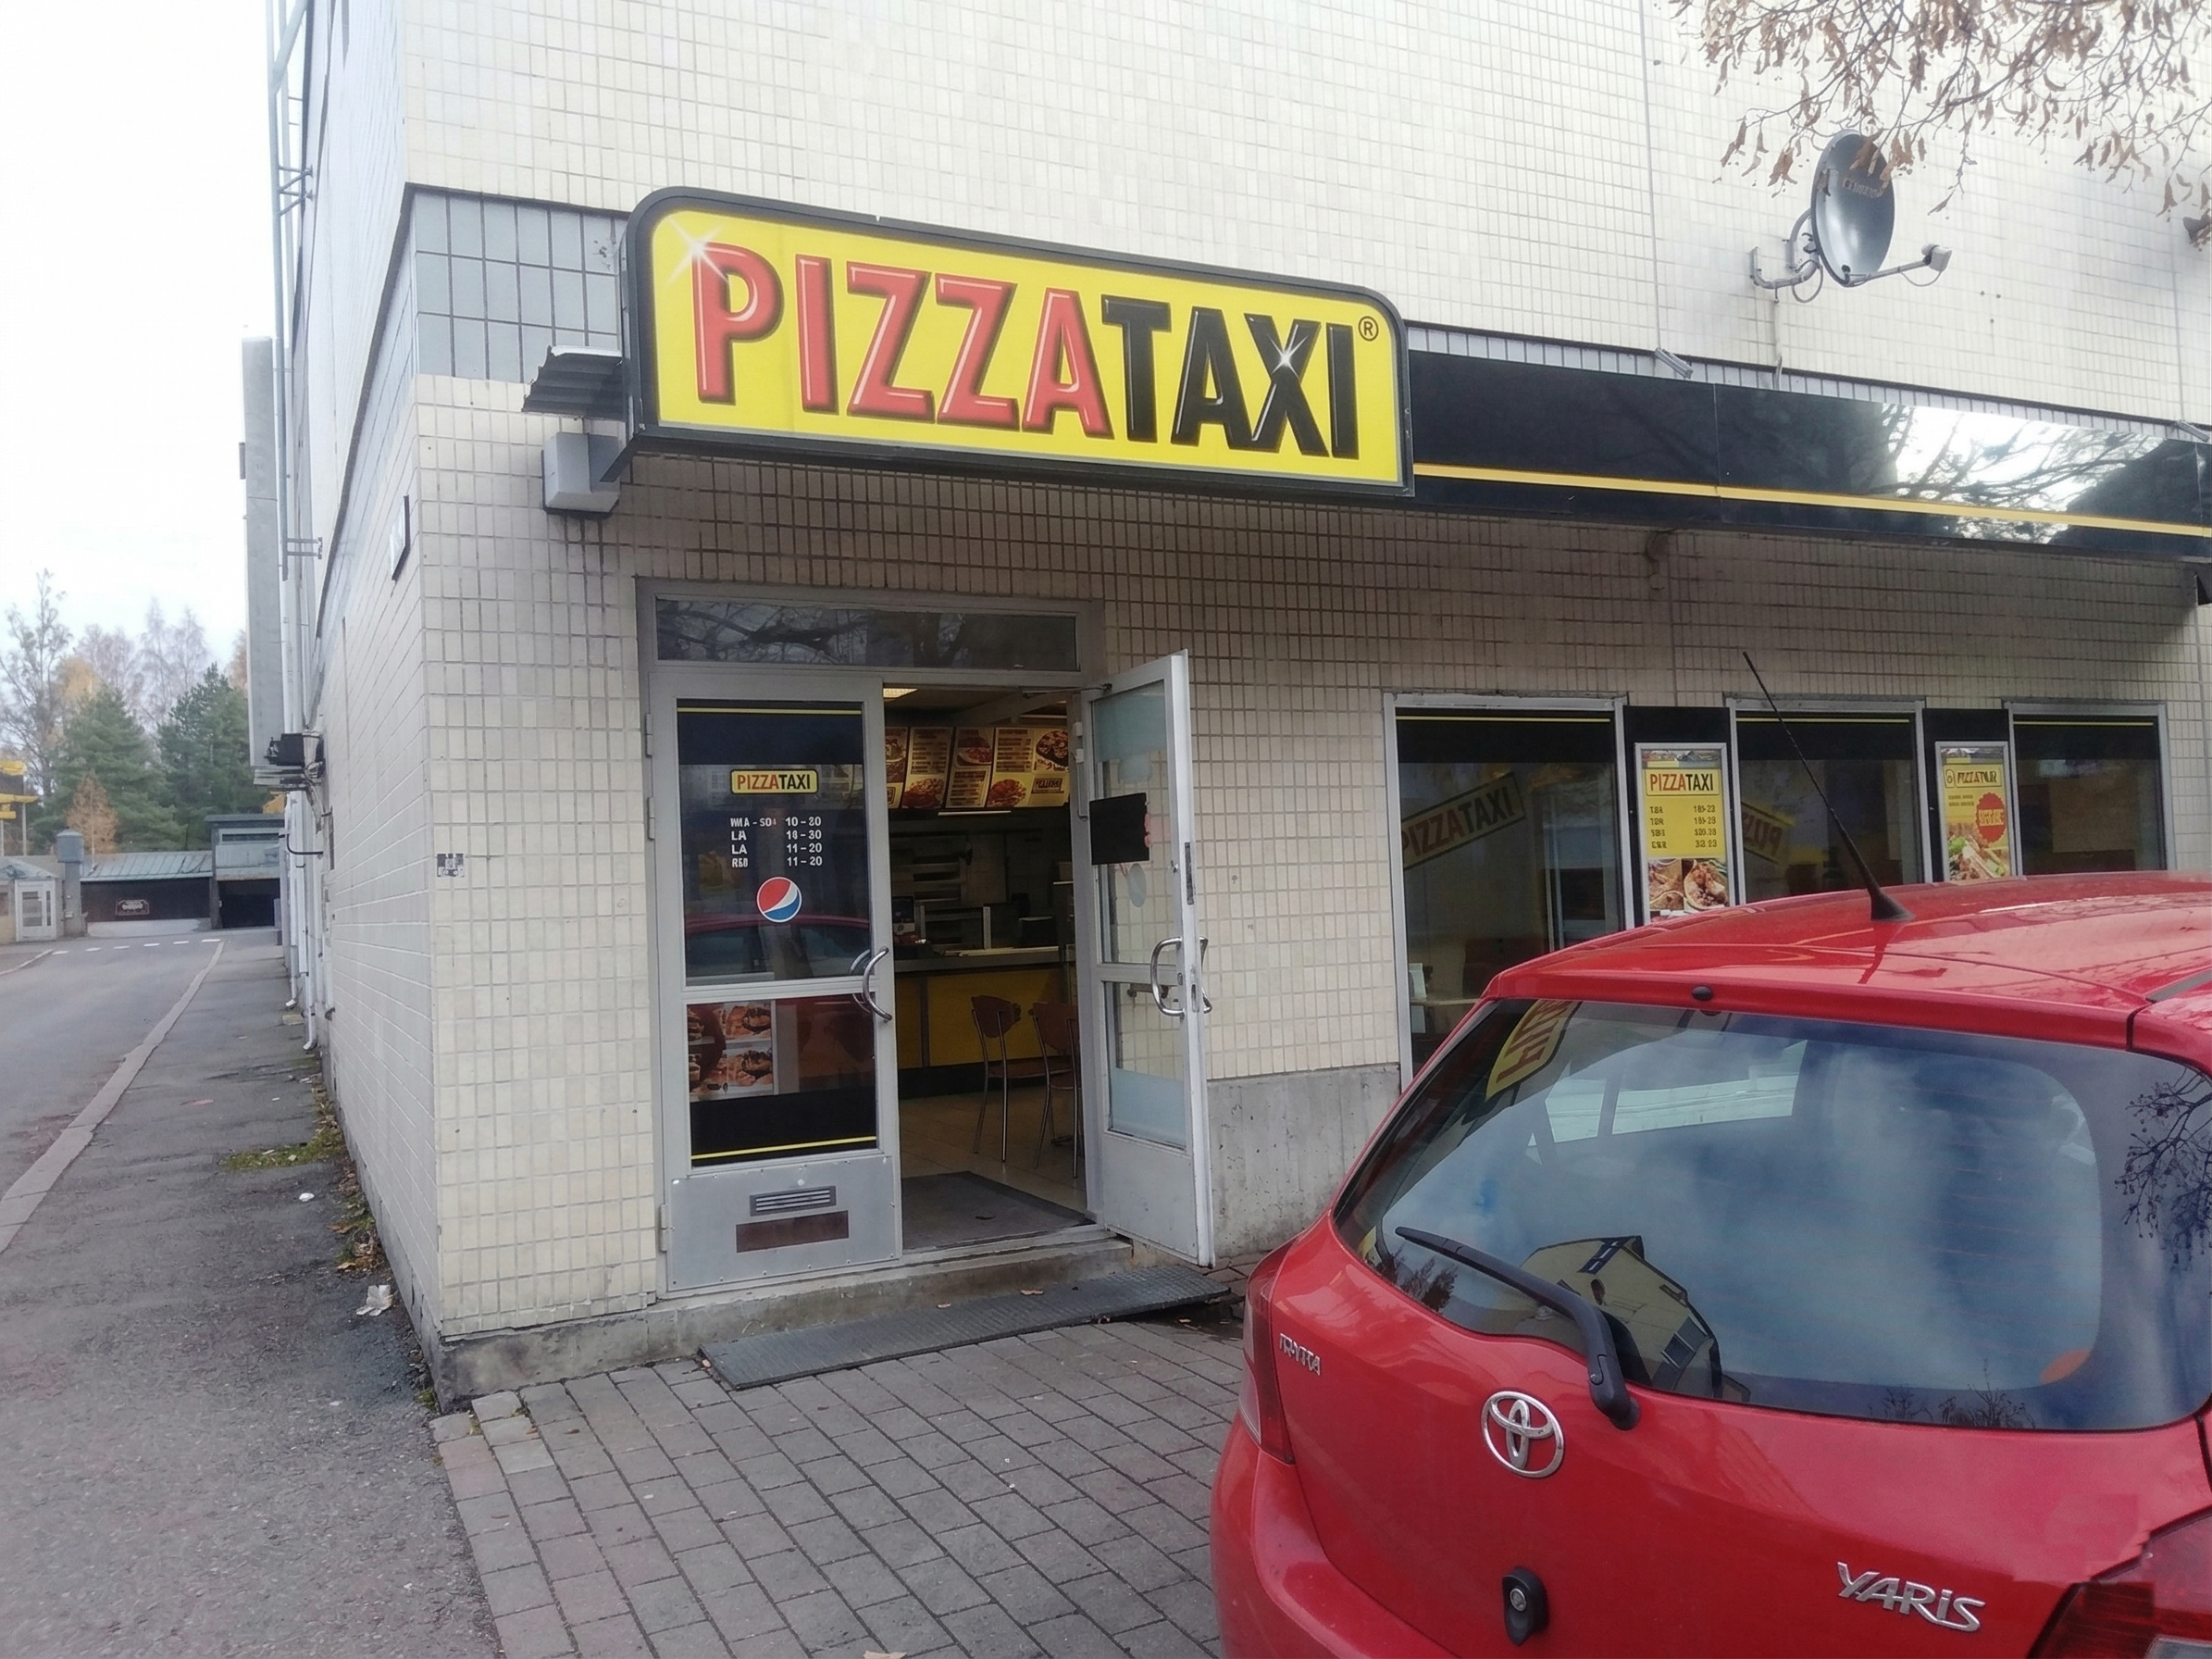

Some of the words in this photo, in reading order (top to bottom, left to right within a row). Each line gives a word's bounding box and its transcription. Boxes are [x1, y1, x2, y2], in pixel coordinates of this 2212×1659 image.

[737, 774, 811, 791] PIZZATAXI
[1649, 773, 1714, 792] PIZZATAXI
[809, 842, 823, 853] 20
[809, 856, 823, 867] 20
